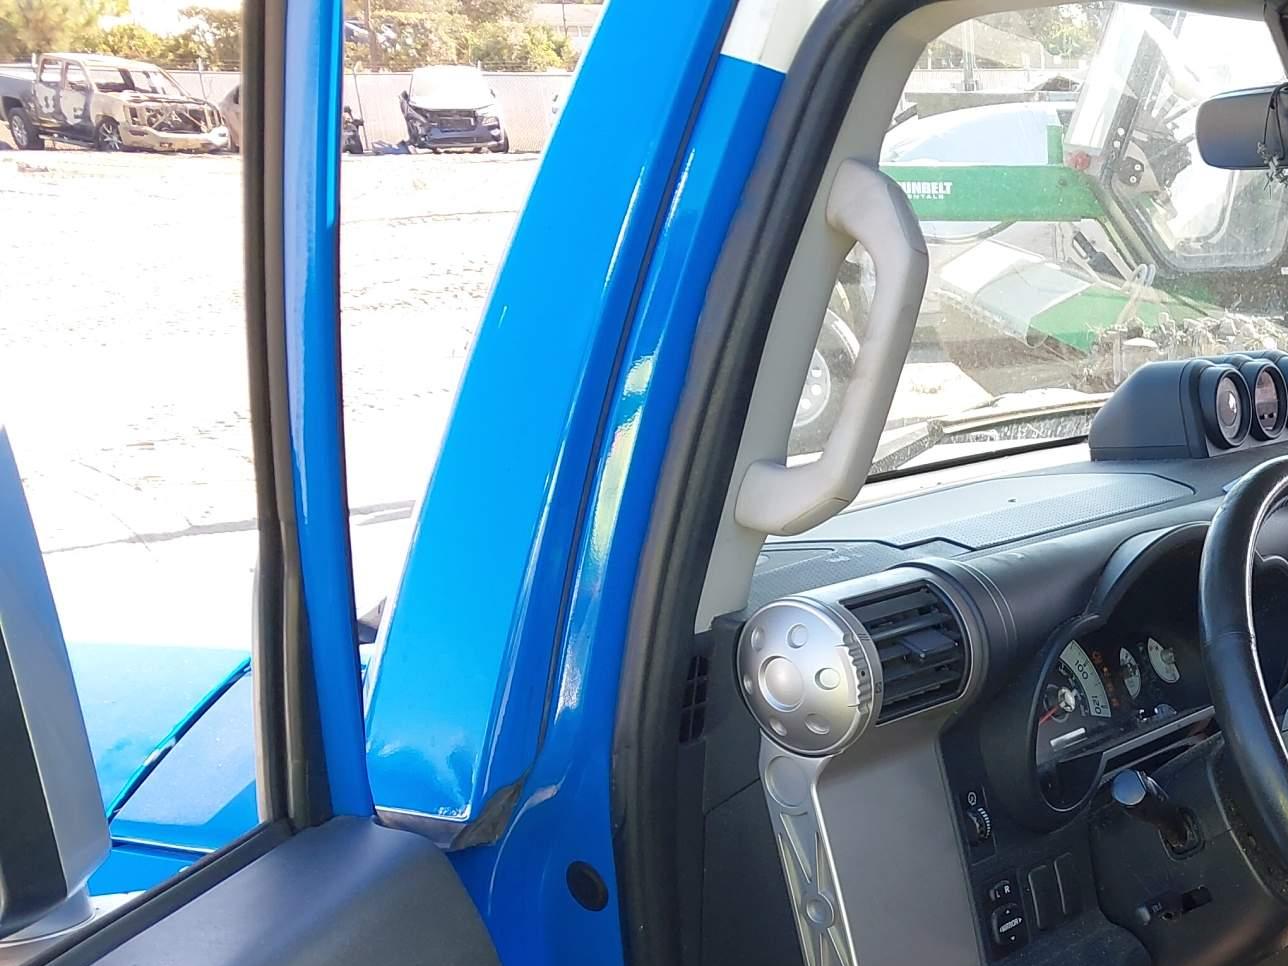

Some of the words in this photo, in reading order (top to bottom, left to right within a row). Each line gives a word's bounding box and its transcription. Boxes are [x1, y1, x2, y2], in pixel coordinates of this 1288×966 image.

[1074, 659, 1089, 680] 100
[1091, 695, 1102, 715] 120
[996, 890, 1001, 898] L
[1004, 885, 1010, 894] R
